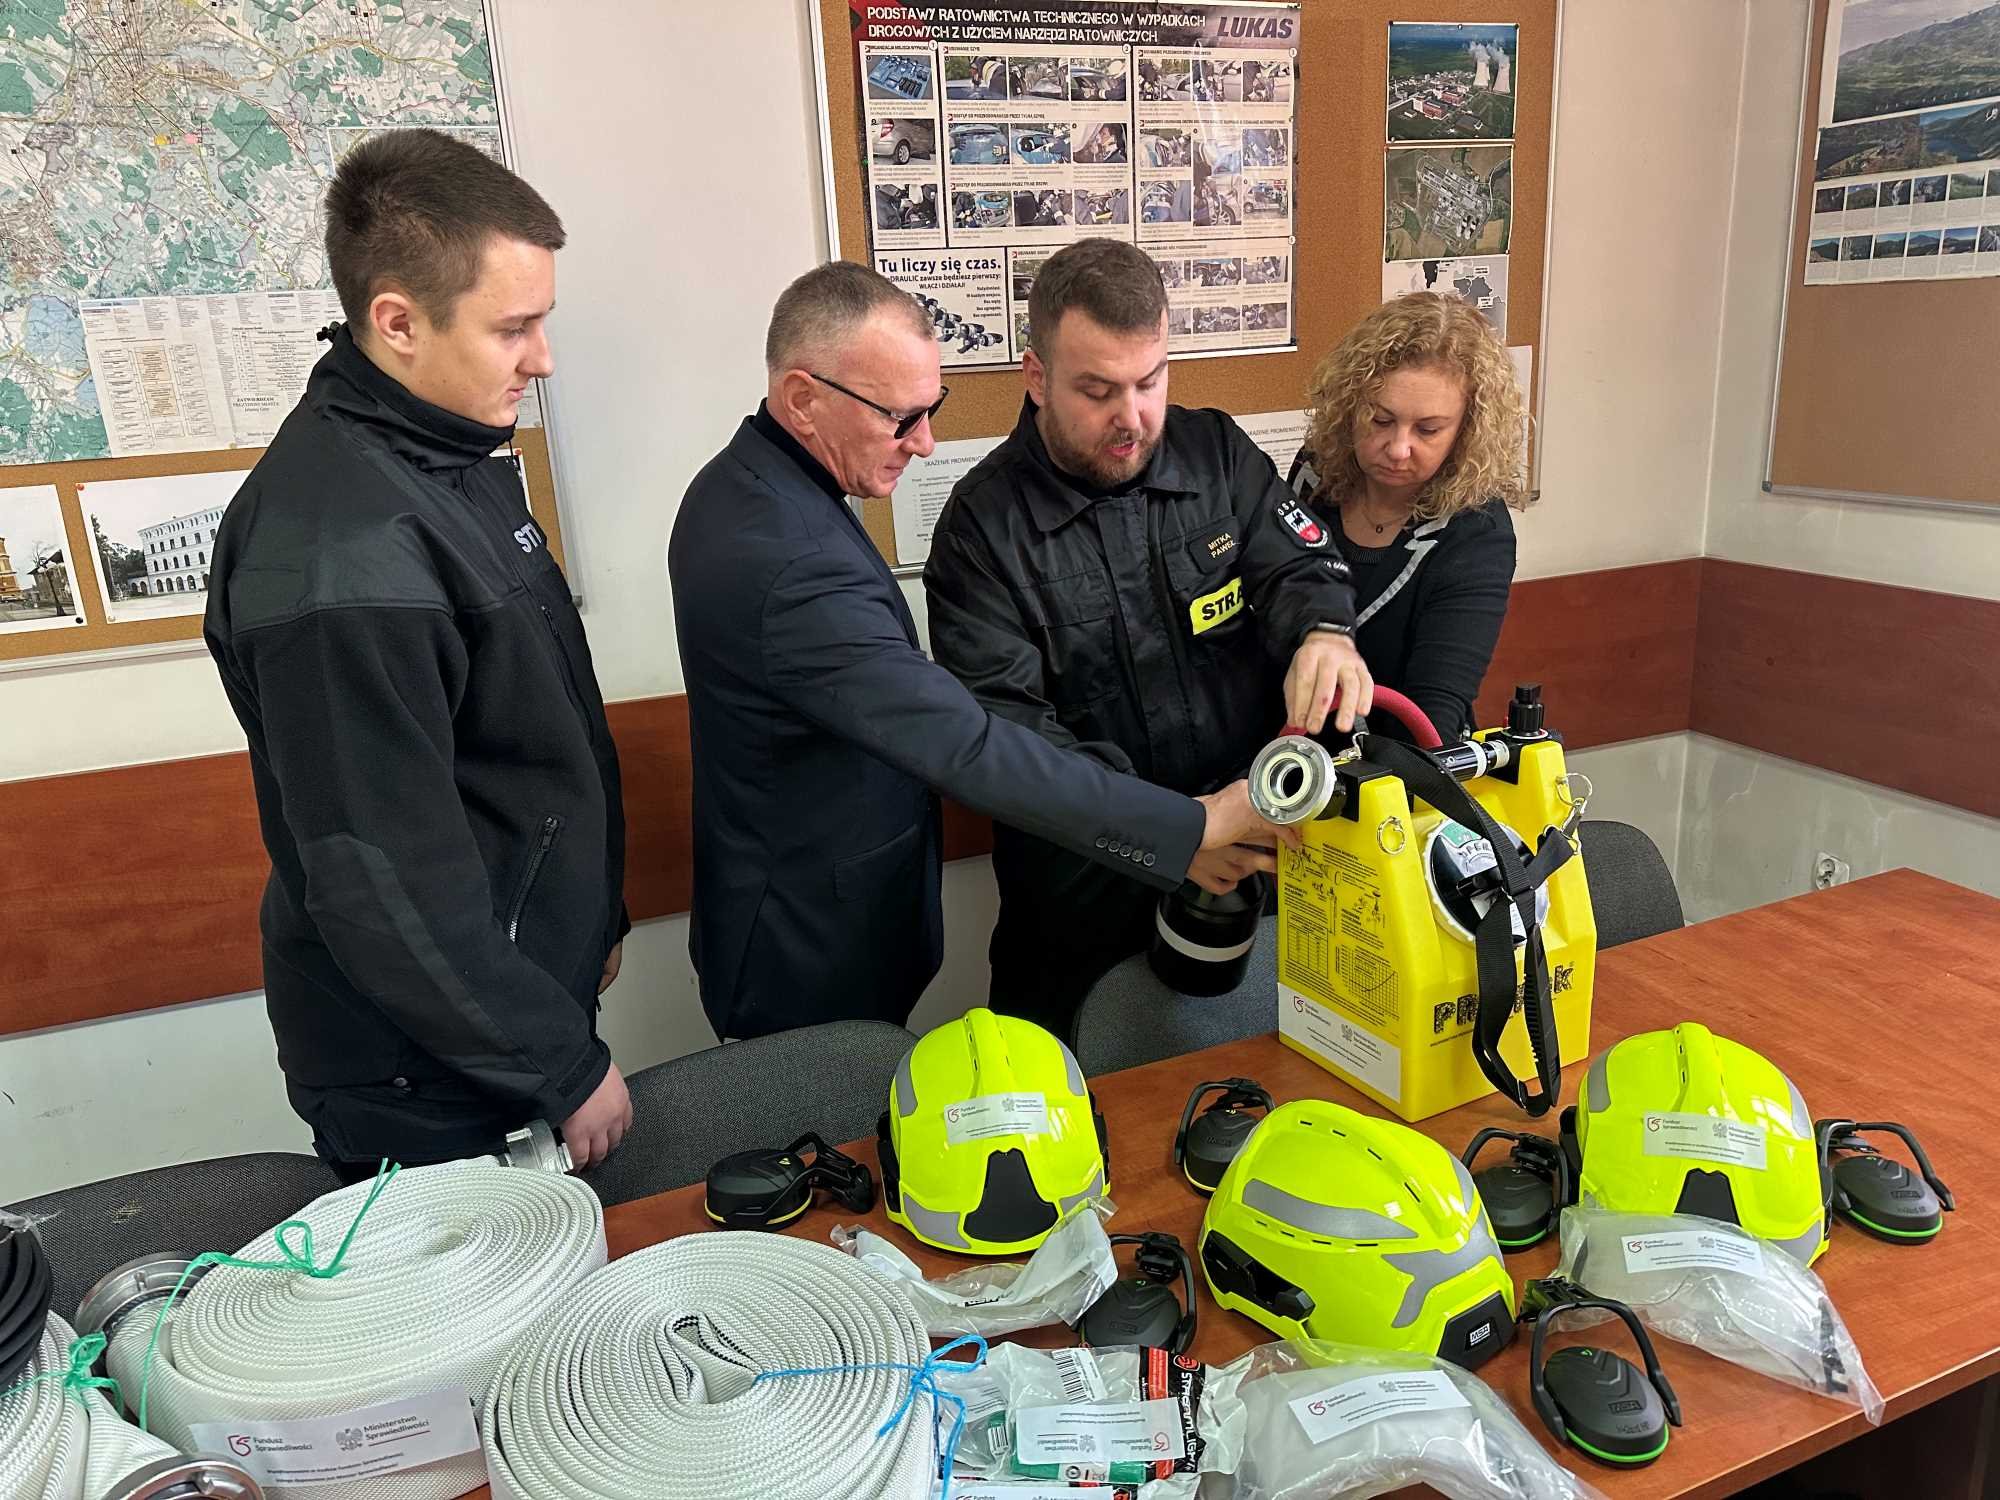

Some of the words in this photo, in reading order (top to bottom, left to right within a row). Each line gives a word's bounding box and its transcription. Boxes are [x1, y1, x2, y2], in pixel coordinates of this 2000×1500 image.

[867, 6, 935, 21] PODSTAWY
[938, 8, 1031, 23] RATOWNICTWA
[1033, 11, 1119, 25] TECHNICZNEGO
[1121, 13, 1133, 26] W
[1136, 14, 1206, 27] WYPADKACH
[868, 24, 949, 38] DROGOWYCH
[951, 26, 960, 39] Z
[962, 24, 1012, 40] UŻYCIEM
[1014, 28, 1067, 43] NARZĘDZI
[1069, 29, 1158, 43] RATOWNICZYCH
[1217, 16, 1293, 39] LUKAS
[879, 258, 897, 272] Tu
[901, 257, 936, 275] liczy
[941, 256, 962, 274] się
[966, 258, 1001, 271] czas.
[888, 275, 919, 283] DRAULIC
[943, 273, 971, 283] będziesz
[1277, 500, 1296, 516] OSP
[1207, 532, 1232, 551] MITKA
[1471, 1325, 1489, 1340] MSA
[364, 1415, 417, 1433] Ministerstwo
[1181, 1372, 1198, 1467] STREAMLIGHT
[365, 1419, 431, 1441] Sprawiedliwości
[253, 1436, 284, 1445] Fundusz
[255, 1443, 313, 1453] Sprawiedliwości
